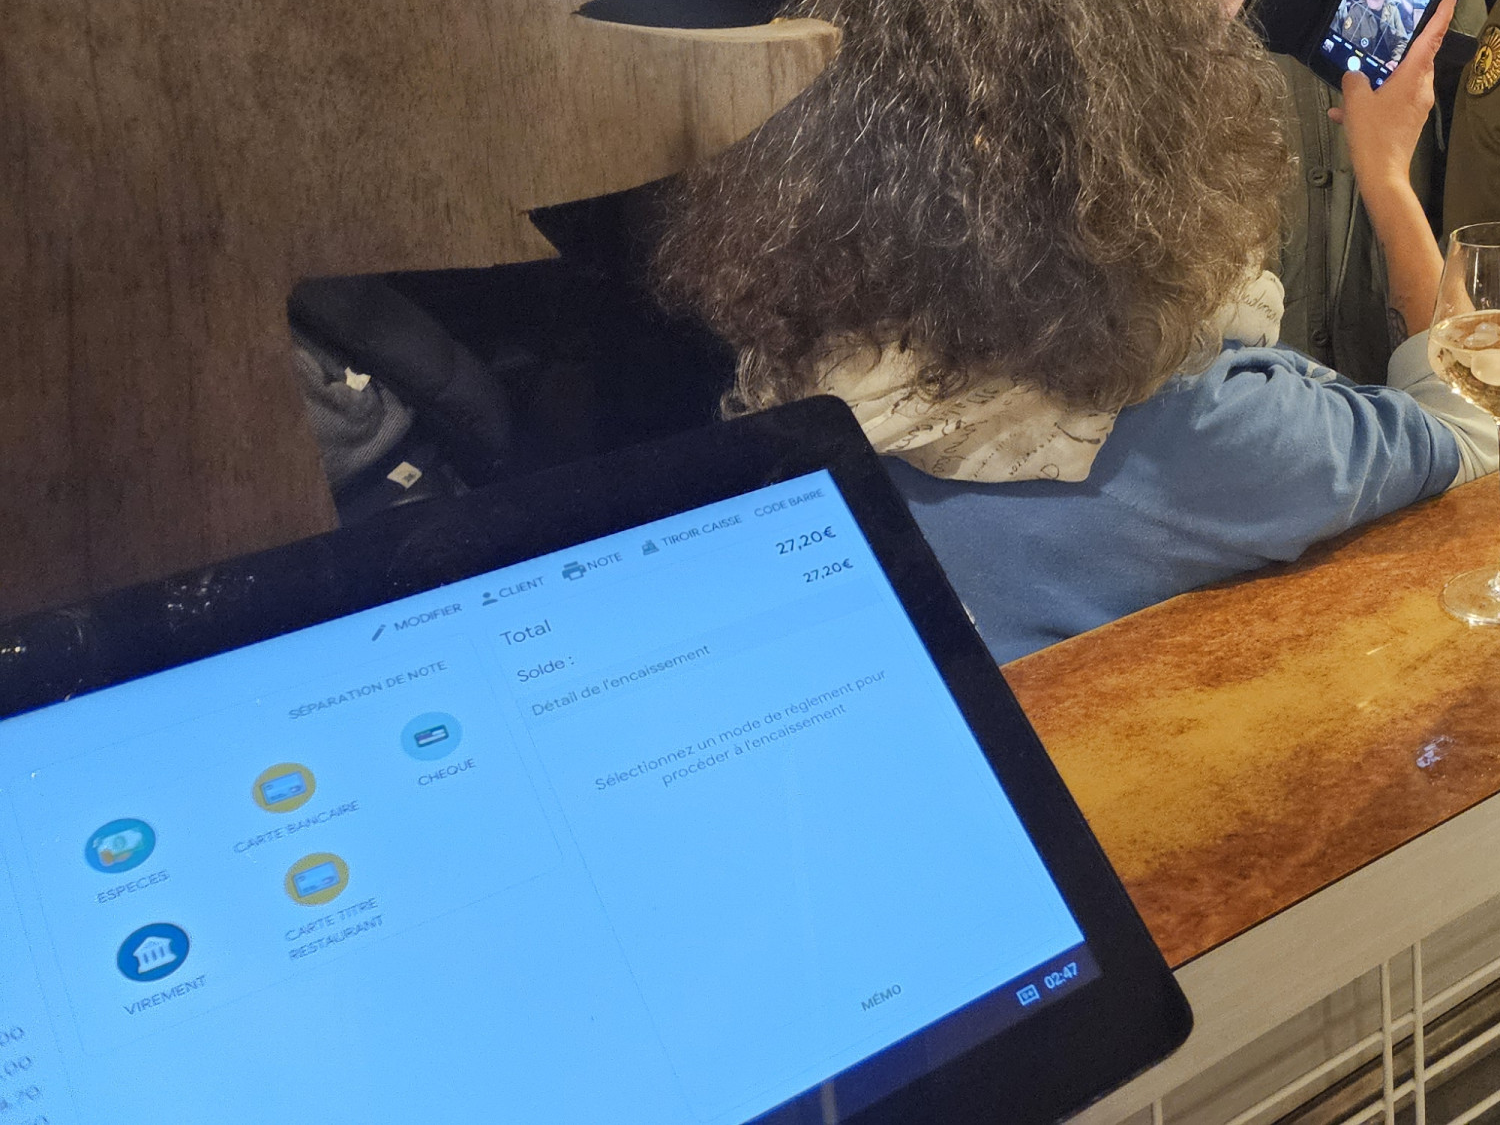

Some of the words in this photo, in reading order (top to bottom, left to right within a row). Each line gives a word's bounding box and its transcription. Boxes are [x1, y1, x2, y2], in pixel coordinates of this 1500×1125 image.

[754, 501, 787, 518] CODE
[789, 488, 825, 508] BARRE
[662, 529, 700, 547] TIROIR
[702, 515, 743, 533] CAISSE
[587, 552, 623, 571] NOTE
[499, 577, 546, 599] CLIENT
[500, 619, 552, 646] Total
[776, 526, 836, 555] 27,20€
[394, 603, 463, 632] MODIFIER
[517, 658, 566, 683] Solde
[803, 558, 854, 583] 27,20€
[386, 674, 407, 689] DE
[407, 660, 449, 681] NOTE
[532, 691, 578, 716] Détail
[581, 683, 601, 700] de
[603, 645, 710, 691] l'encaissement
[595, 745, 696, 791] Sélectionnez
[697, 736, 717, 751] un
[719, 716, 762, 744] mode
[764, 709, 783, 725] de
[785, 682, 855, 717] règlement
[855, 668, 886, 693] pour
[662, 748, 731, 788] procéder
[734, 743, 744, 756] à
[745, 703, 846, 753] l'encaissement
[417, 757, 477, 786] CHEQUE
[233, 828, 284, 854] CARTE
[286, 800, 360, 835] BANCAIRE
[96, 869, 170, 905] ESPECES
[285, 913, 335, 942] CARTE
[337, 897, 379, 922] TITRE
[288, 914, 384, 961] RESTAURANT
[1043, 961, 1079, 990] 02:47
[123, 975, 206, 1016] VIREMENT
[860, 984, 902, 1012] MÉMO
